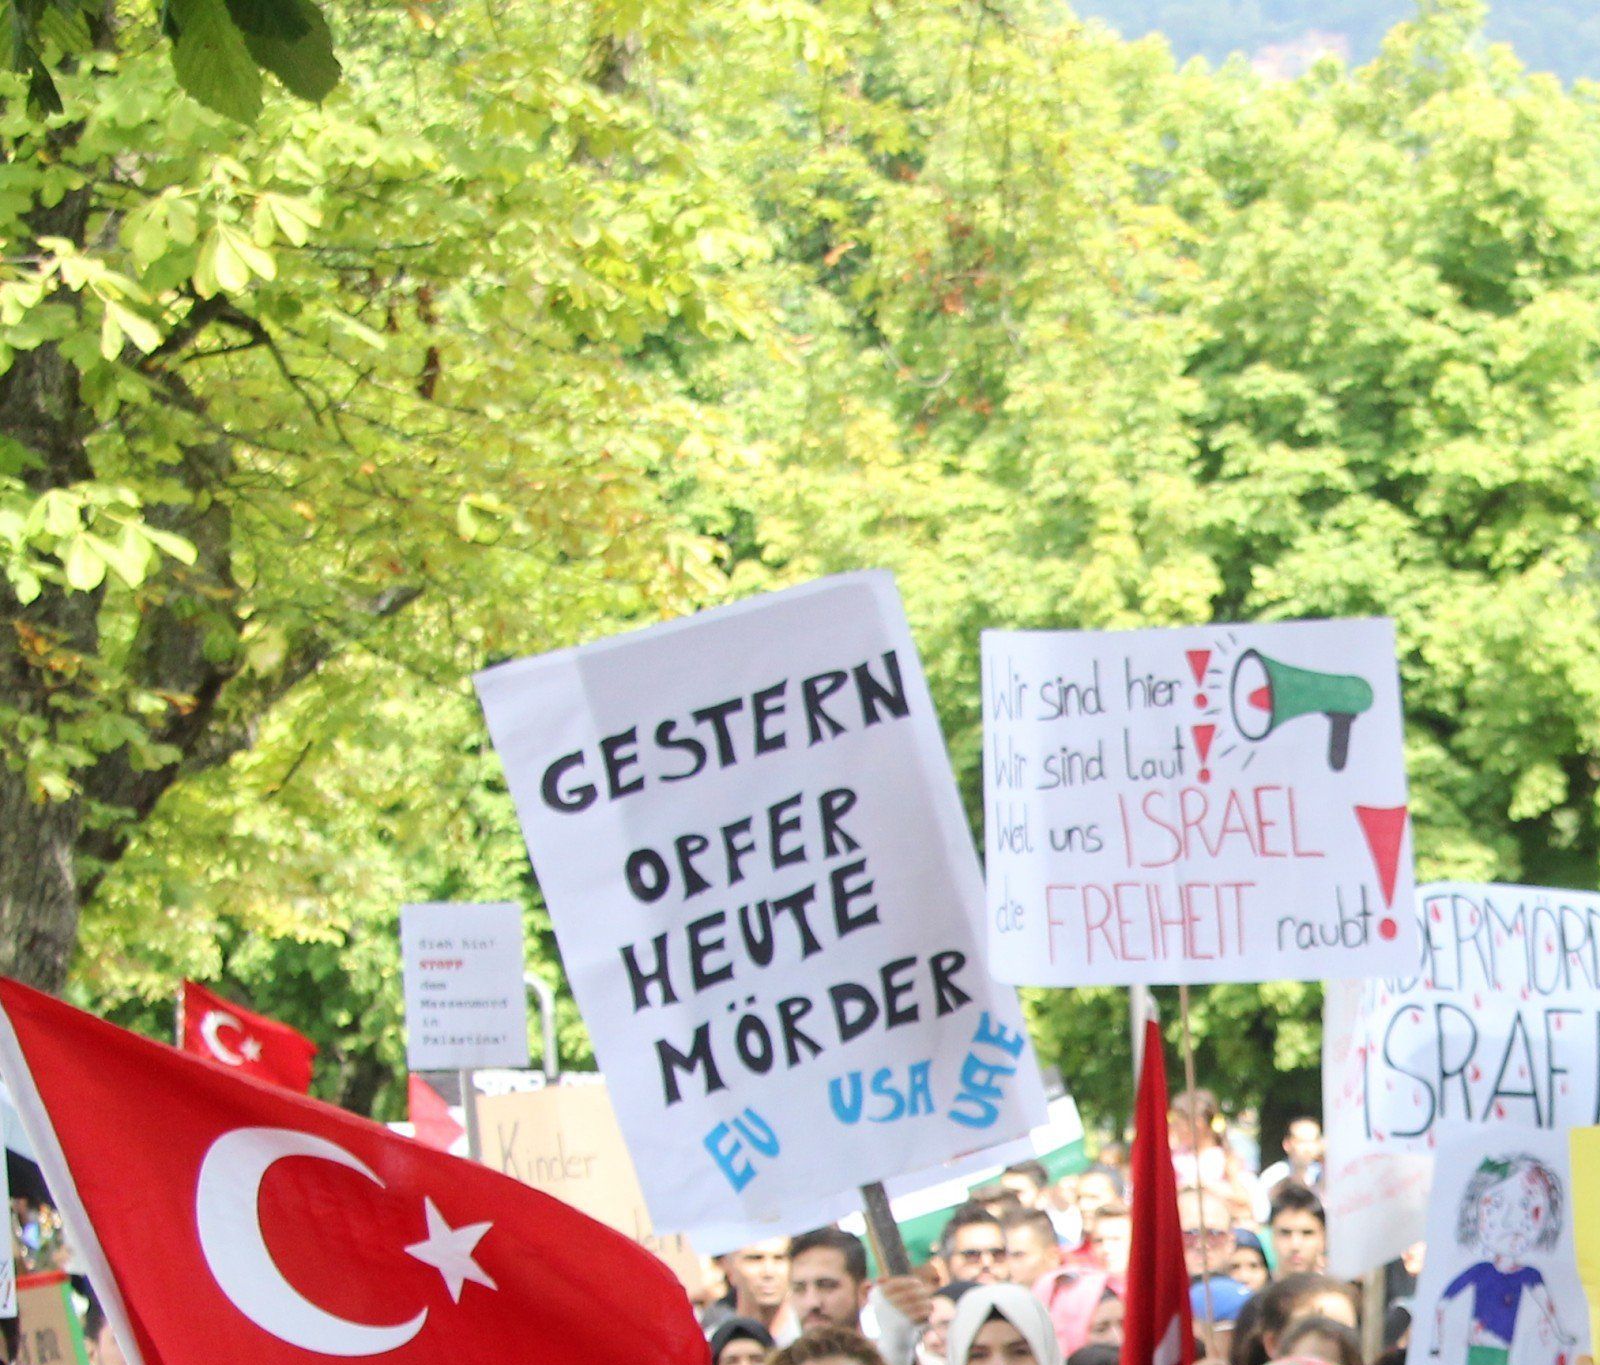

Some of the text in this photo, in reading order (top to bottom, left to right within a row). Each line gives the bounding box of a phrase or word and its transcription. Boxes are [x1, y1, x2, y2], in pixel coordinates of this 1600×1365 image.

[541, 650, 911, 814] GESTERN
[991, 656, 1028, 721] Wir
[1038, 659, 1105, 721] sind
[994, 731, 1028, 790] Wir
[1036, 739, 1106, 790] sind
[623, 785, 862, 904] OPFER
[996, 785, 1325, 868] Weil uns ISRAEL
[619, 858, 880, 1014] HEUTE
[996, 874, 1025, 934] die
[1045, 881, 1257, 965] FREIHEIT
[655, 948, 974, 1106] MÖRDER
[497, 1120, 599, 1184] Kinder
[702, 1011, 1025, 1194] EU USA UAE
